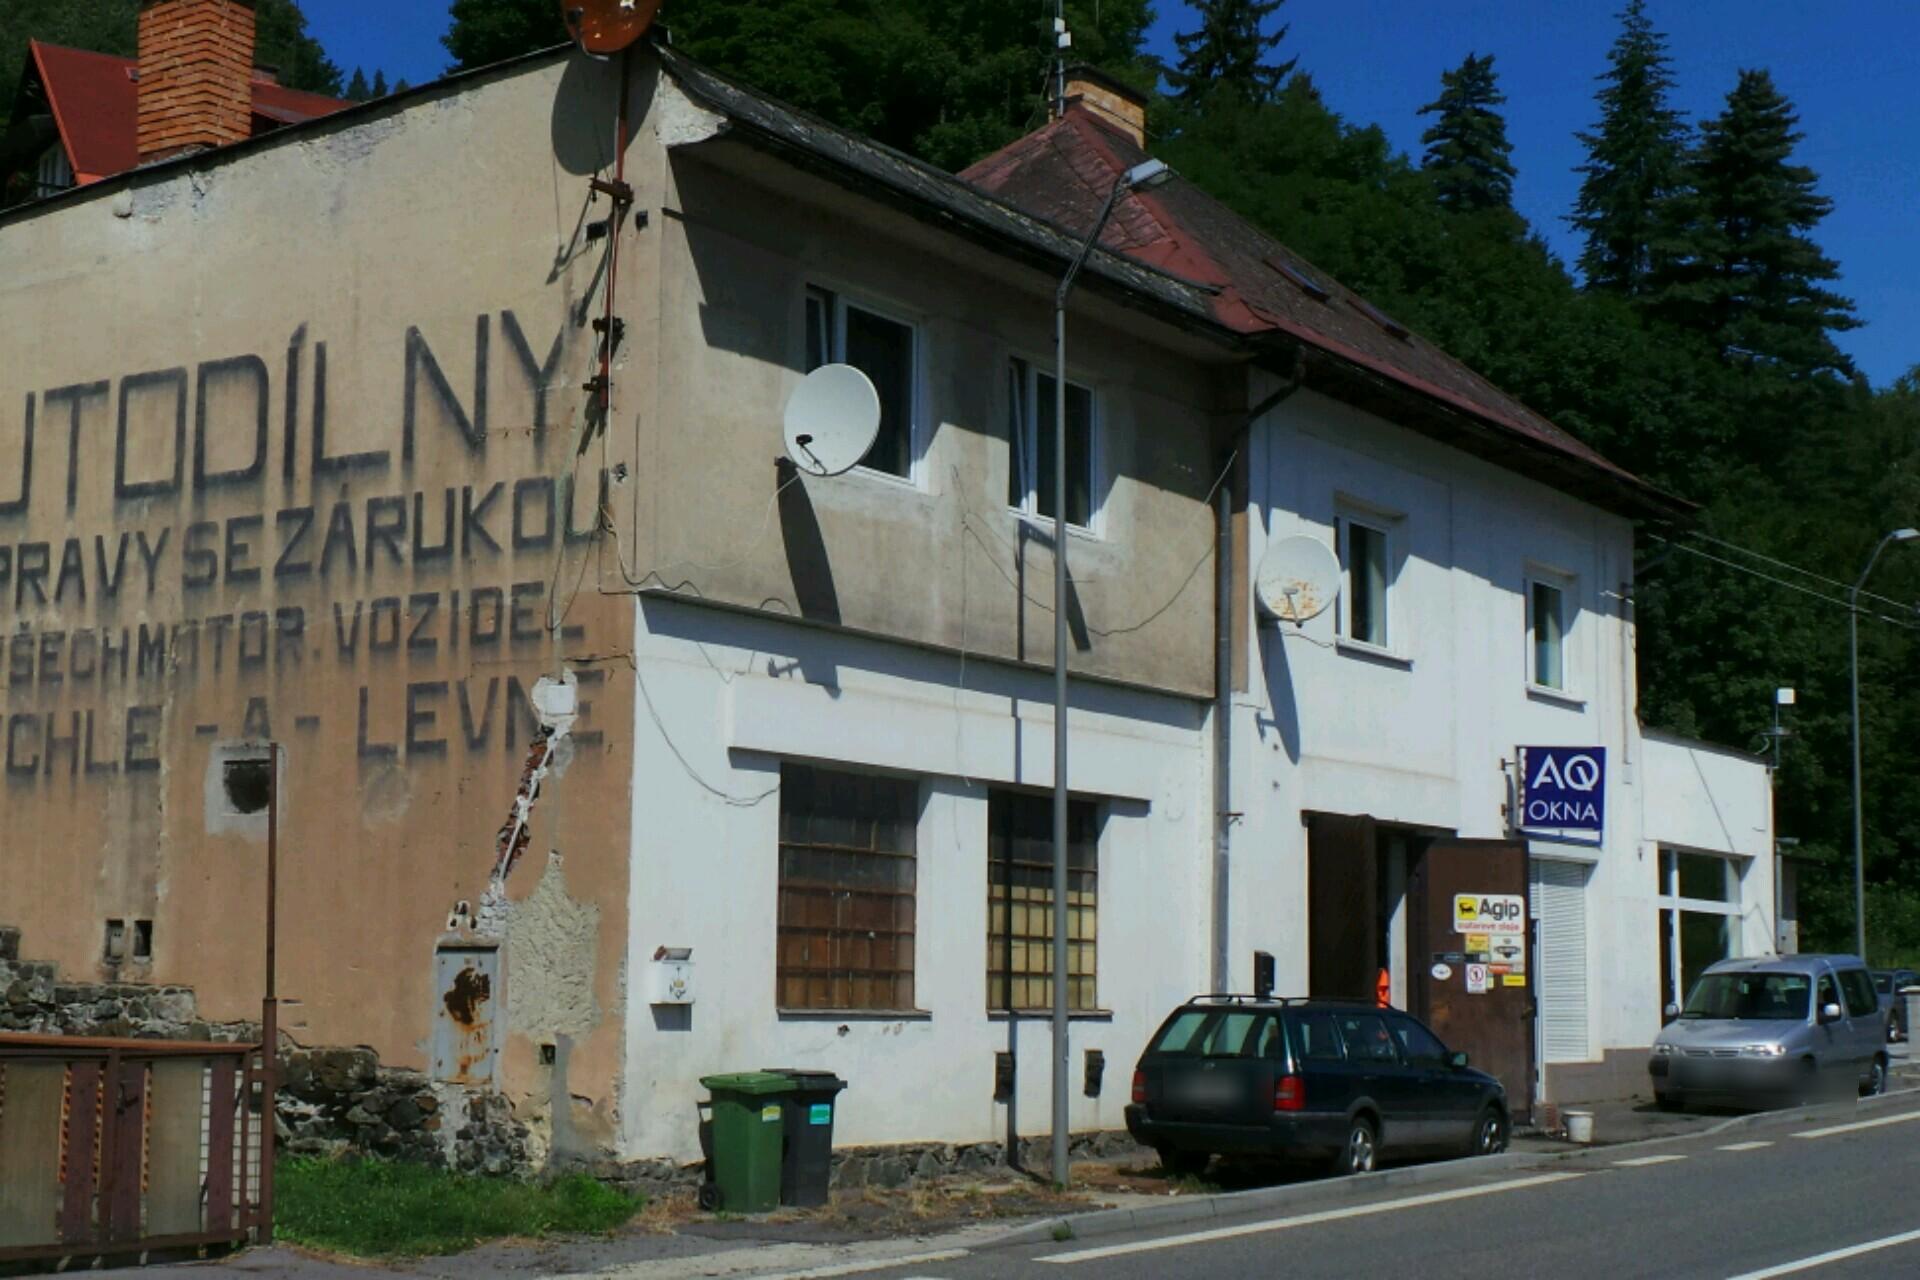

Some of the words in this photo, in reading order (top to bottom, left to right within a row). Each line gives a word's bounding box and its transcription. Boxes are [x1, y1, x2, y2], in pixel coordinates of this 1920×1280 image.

[1531, 753, 1600, 791] AQ
[1528, 799, 1599, 822] OKNA
[1479, 898, 1520, 921] Agip
